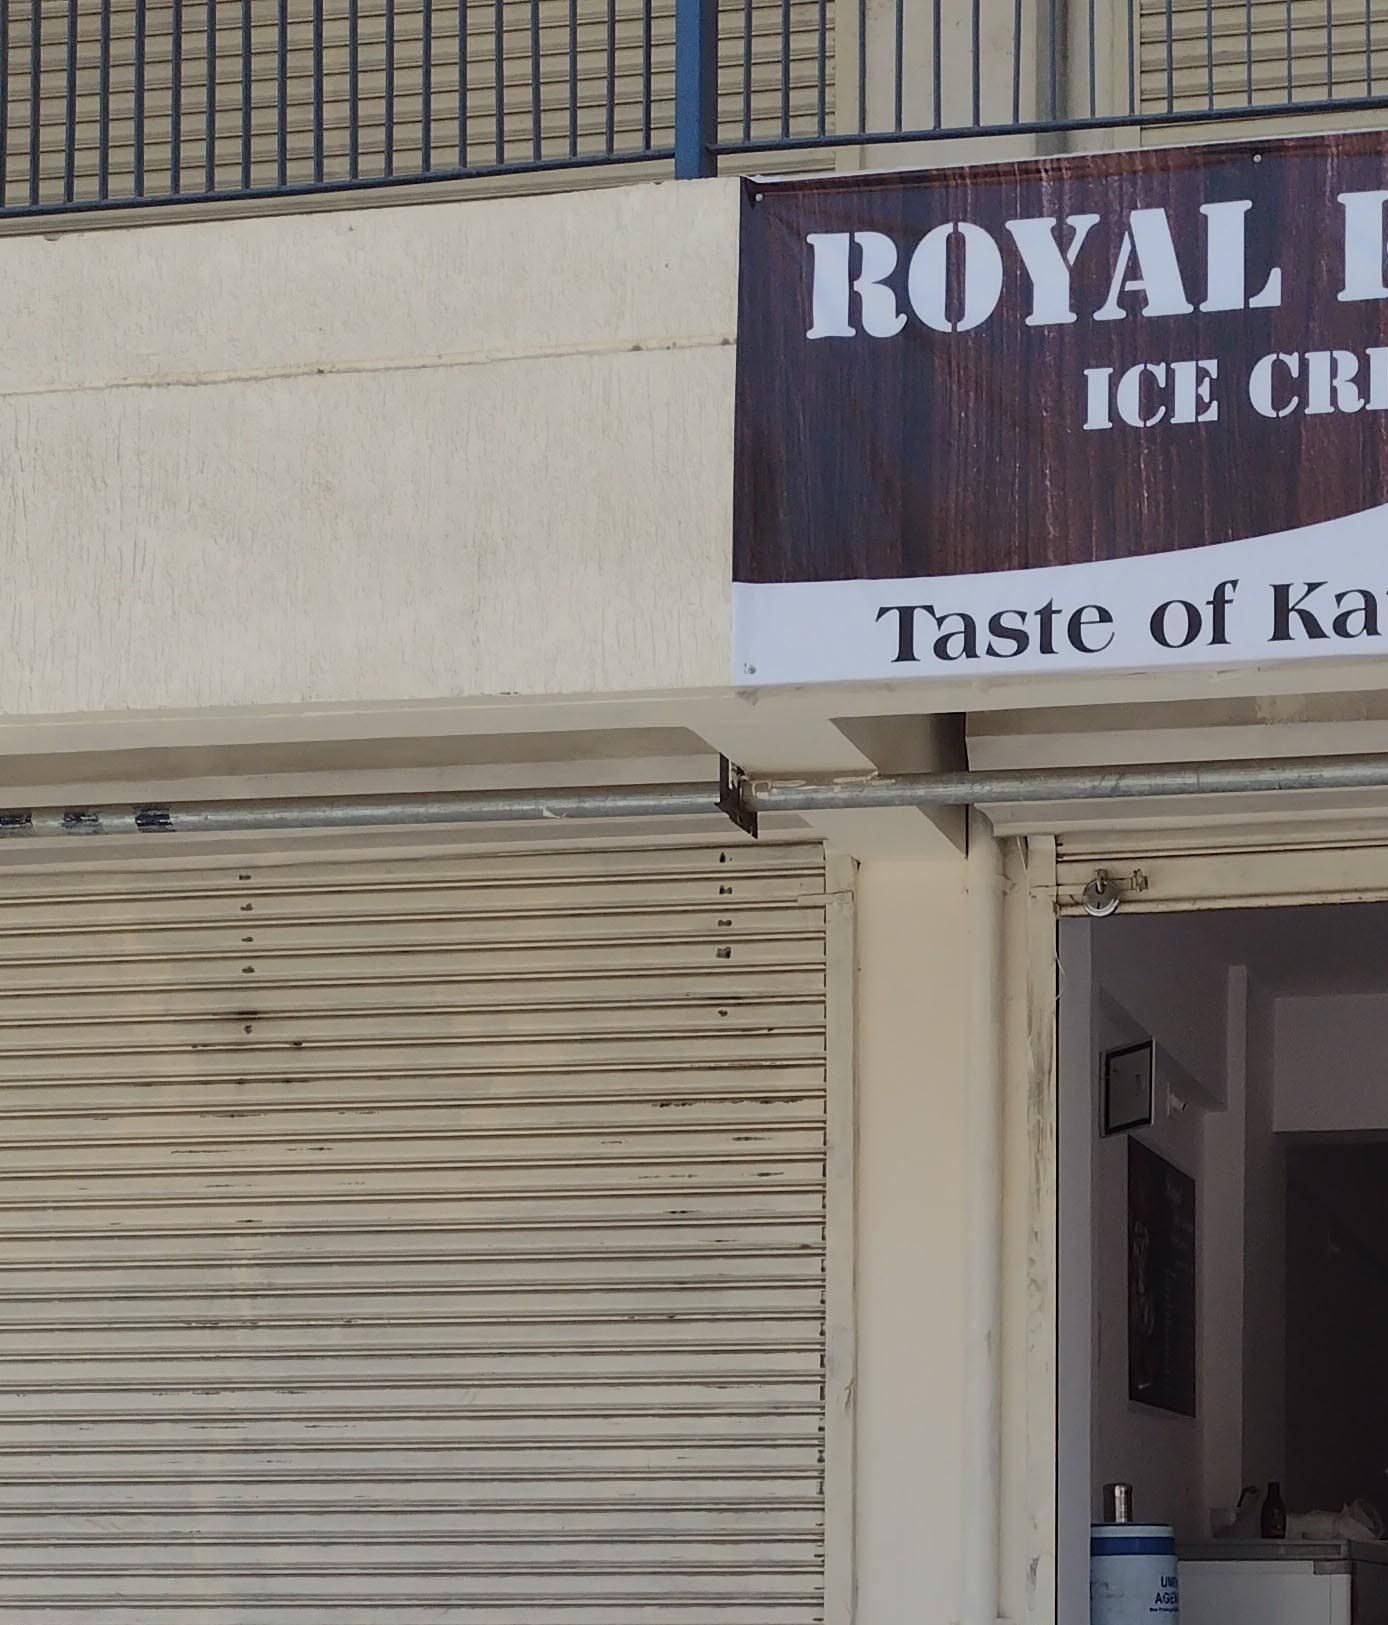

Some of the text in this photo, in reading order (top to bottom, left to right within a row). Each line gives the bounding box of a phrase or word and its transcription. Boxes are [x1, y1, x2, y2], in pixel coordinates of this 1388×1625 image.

[806, 200, 1282, 340] ROYAL
[1083, 358, 1219, 431] ICE
[875, 598, 1116, 664] Taste
[1149, 579, 1239, 650] of
